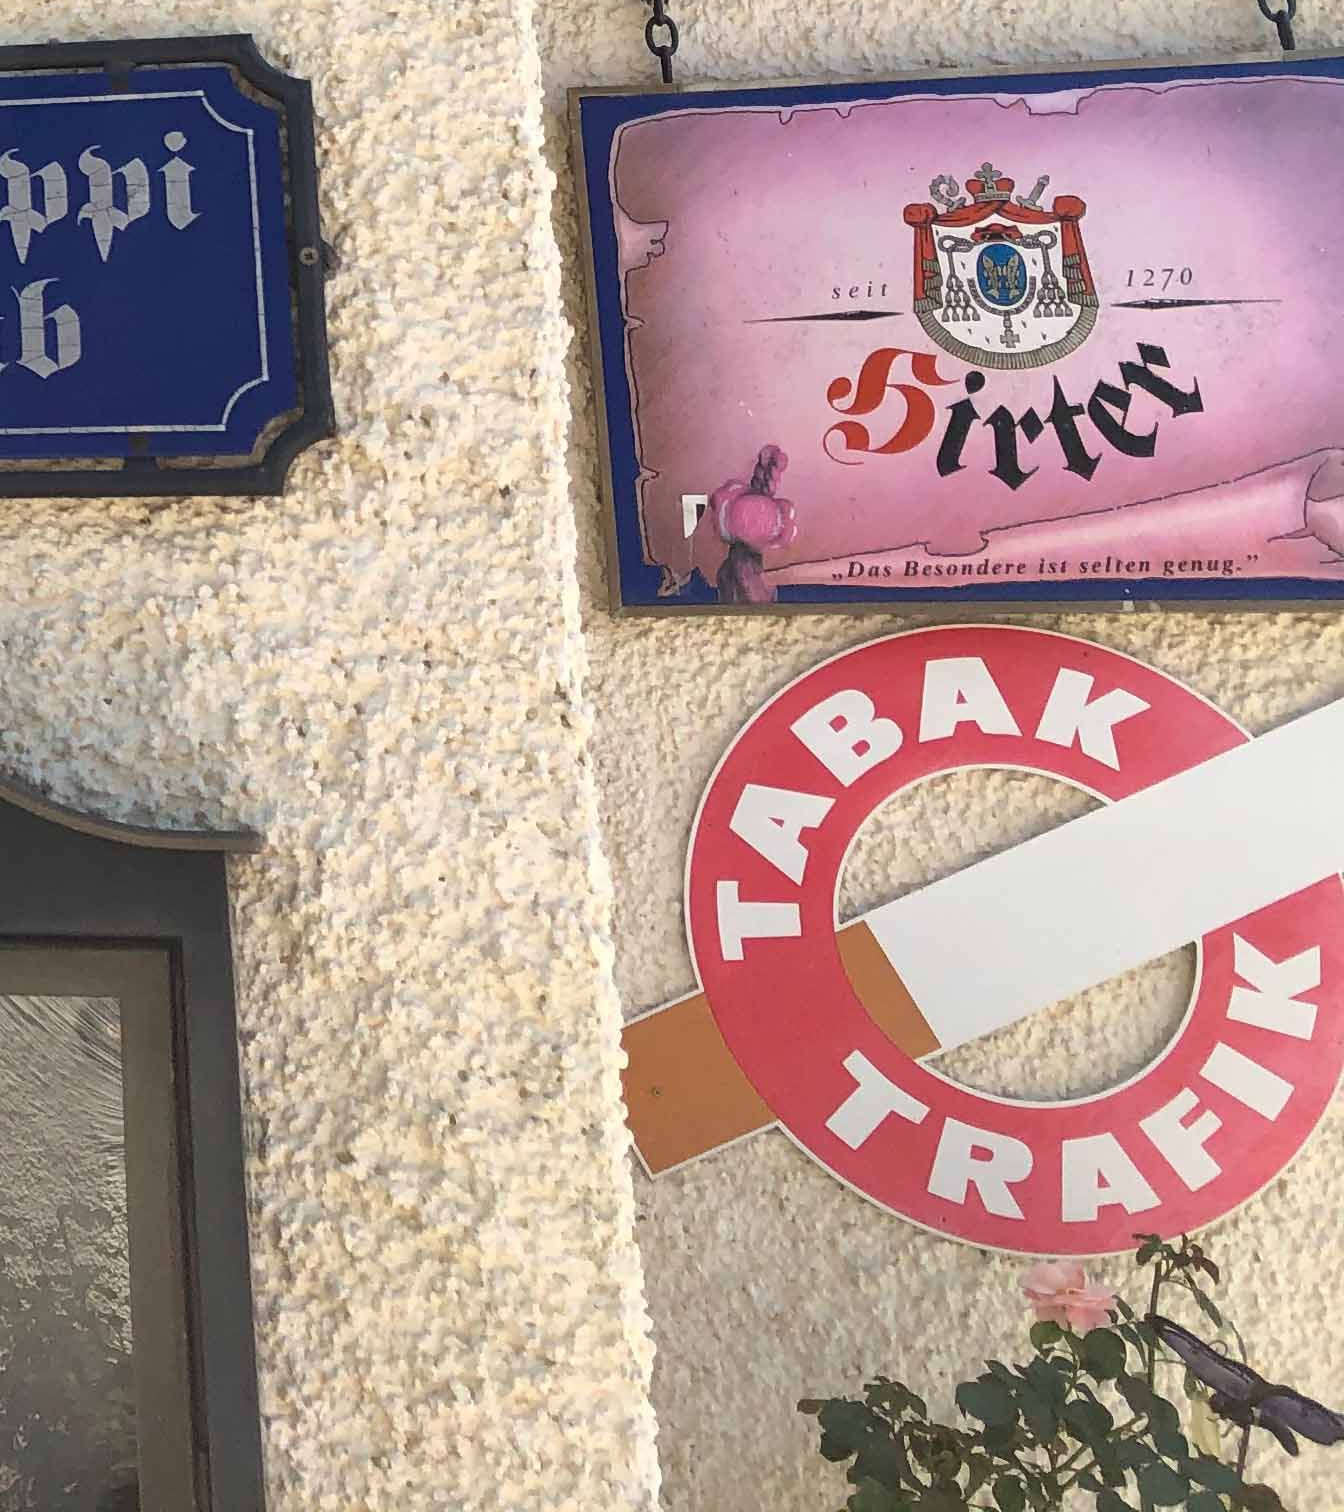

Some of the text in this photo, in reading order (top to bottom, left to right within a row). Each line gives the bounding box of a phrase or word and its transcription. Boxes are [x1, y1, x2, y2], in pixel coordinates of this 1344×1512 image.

[832, 267, 1193, 299] seit 1270
[823, 341, 1206, 490] Hirter
[904, 558, 1027, 578] Besondere
[1039, 557, 1068, 576] ist
[1079, 557, 1151, 574] selten
[717, 656, 1152, 962] TABAK
[825, 931, 1323, 1224] TRAFIK
